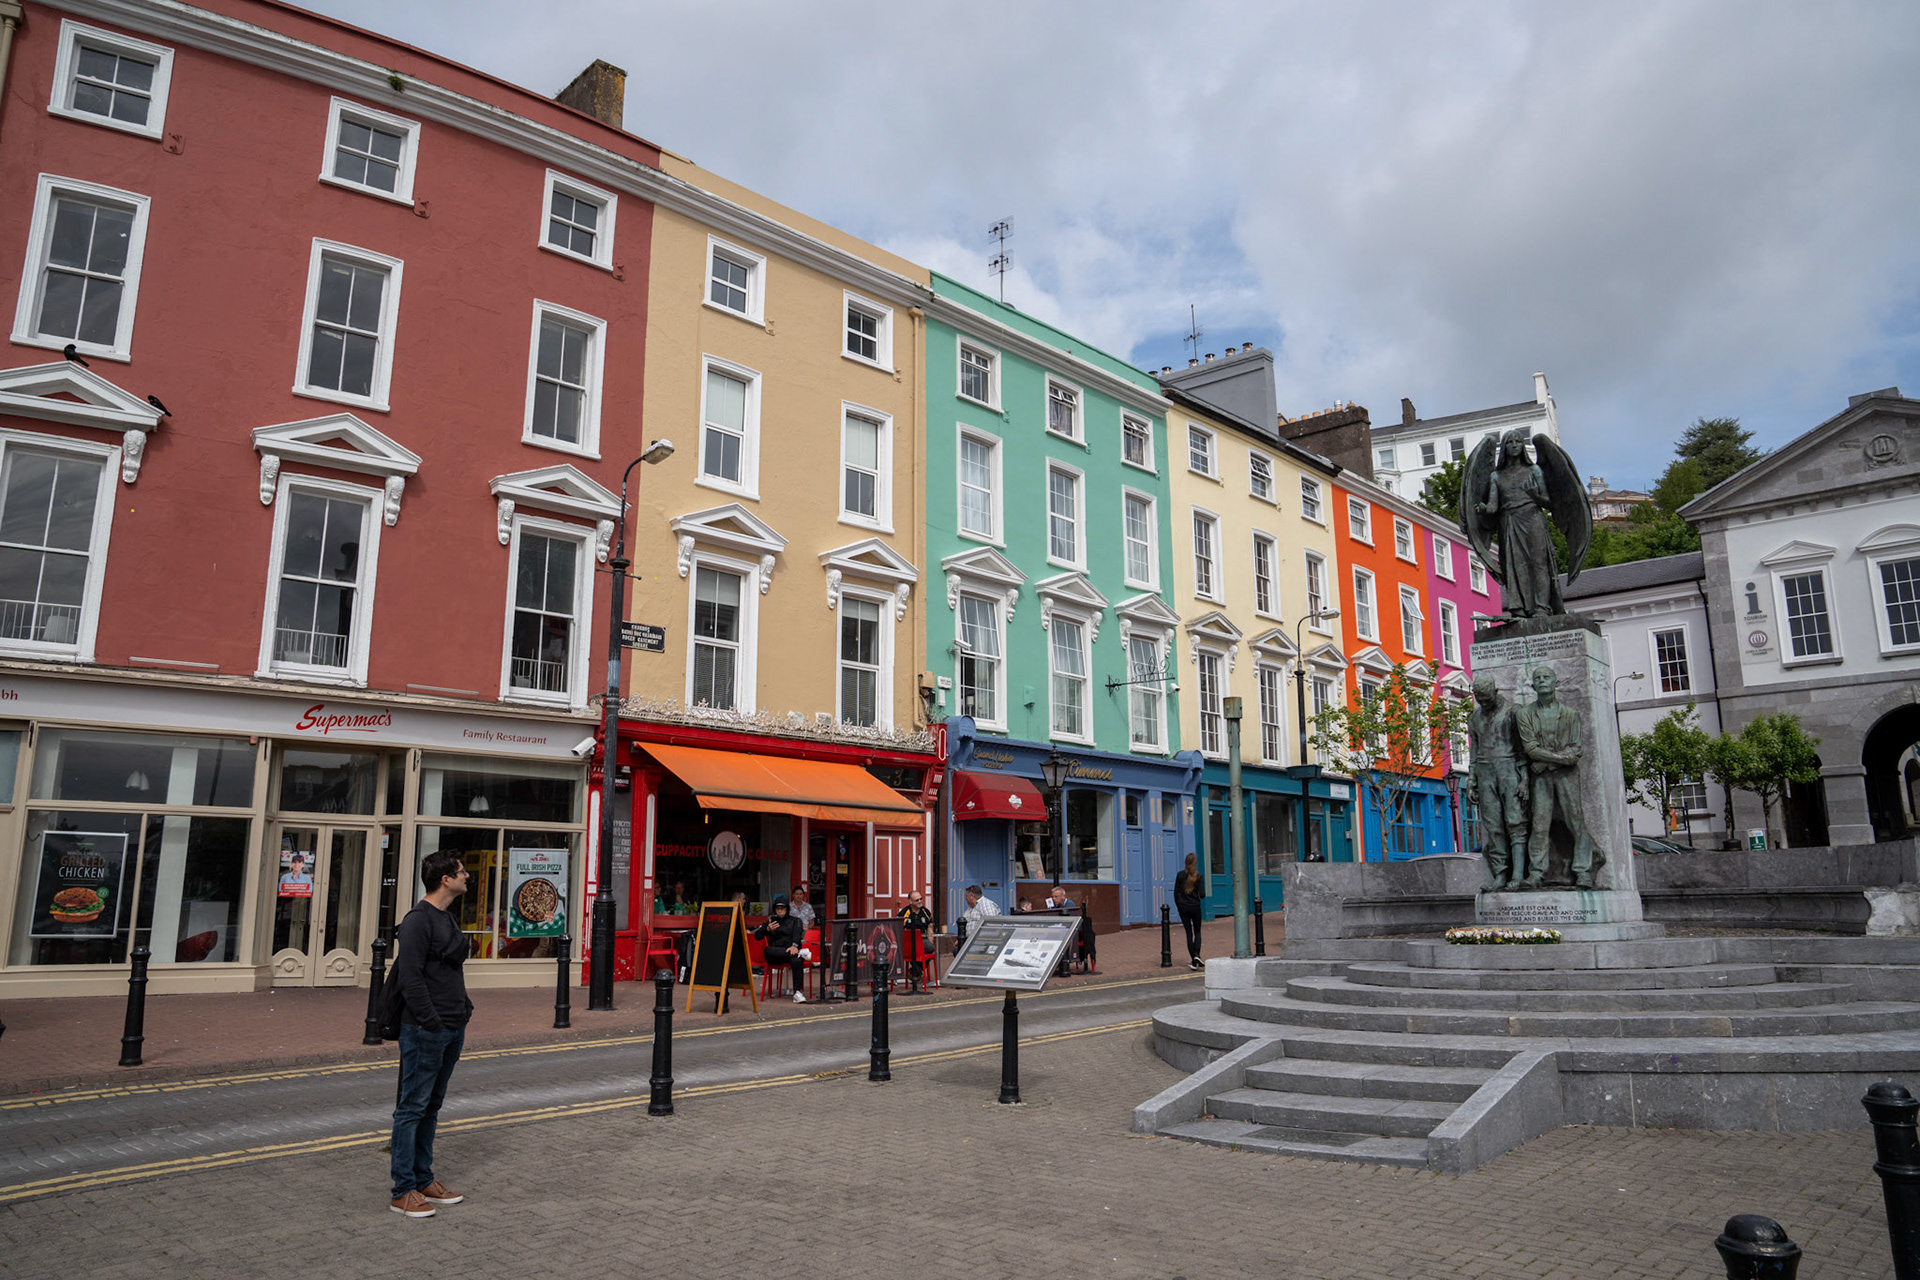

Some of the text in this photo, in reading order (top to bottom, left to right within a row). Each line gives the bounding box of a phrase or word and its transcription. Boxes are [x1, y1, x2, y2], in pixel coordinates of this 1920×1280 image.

[296, 704, 392, 735] Supermac's
[462, 729, 547, 745] Family Restaurant
[655, 844, 789, 861] CUPPACITY COFFEE
[60, 855, 106, 867] GRILLED
[516, 863, 562, 871] FULL IRISH PIZZA
[58, 866, 105, 878] CHICKEN
